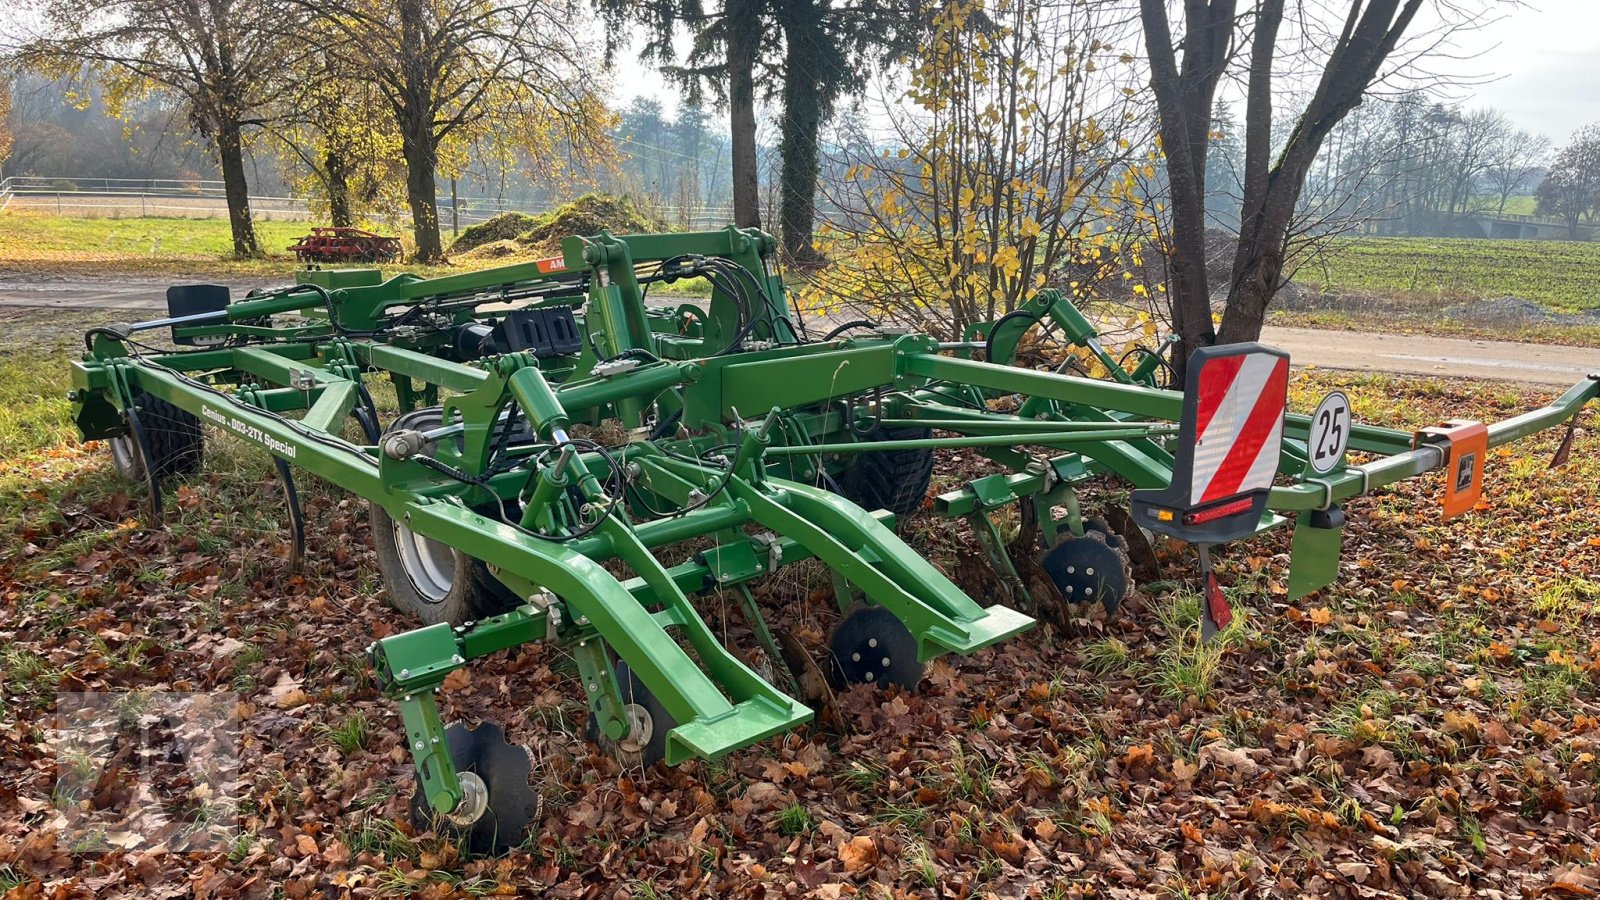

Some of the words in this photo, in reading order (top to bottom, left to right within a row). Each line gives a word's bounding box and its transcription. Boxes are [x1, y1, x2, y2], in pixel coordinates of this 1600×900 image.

[202, 404, 226, 425] Cenius
[264, 433, 296, 458] Special
[1315, 407, 1345, 460] 25
